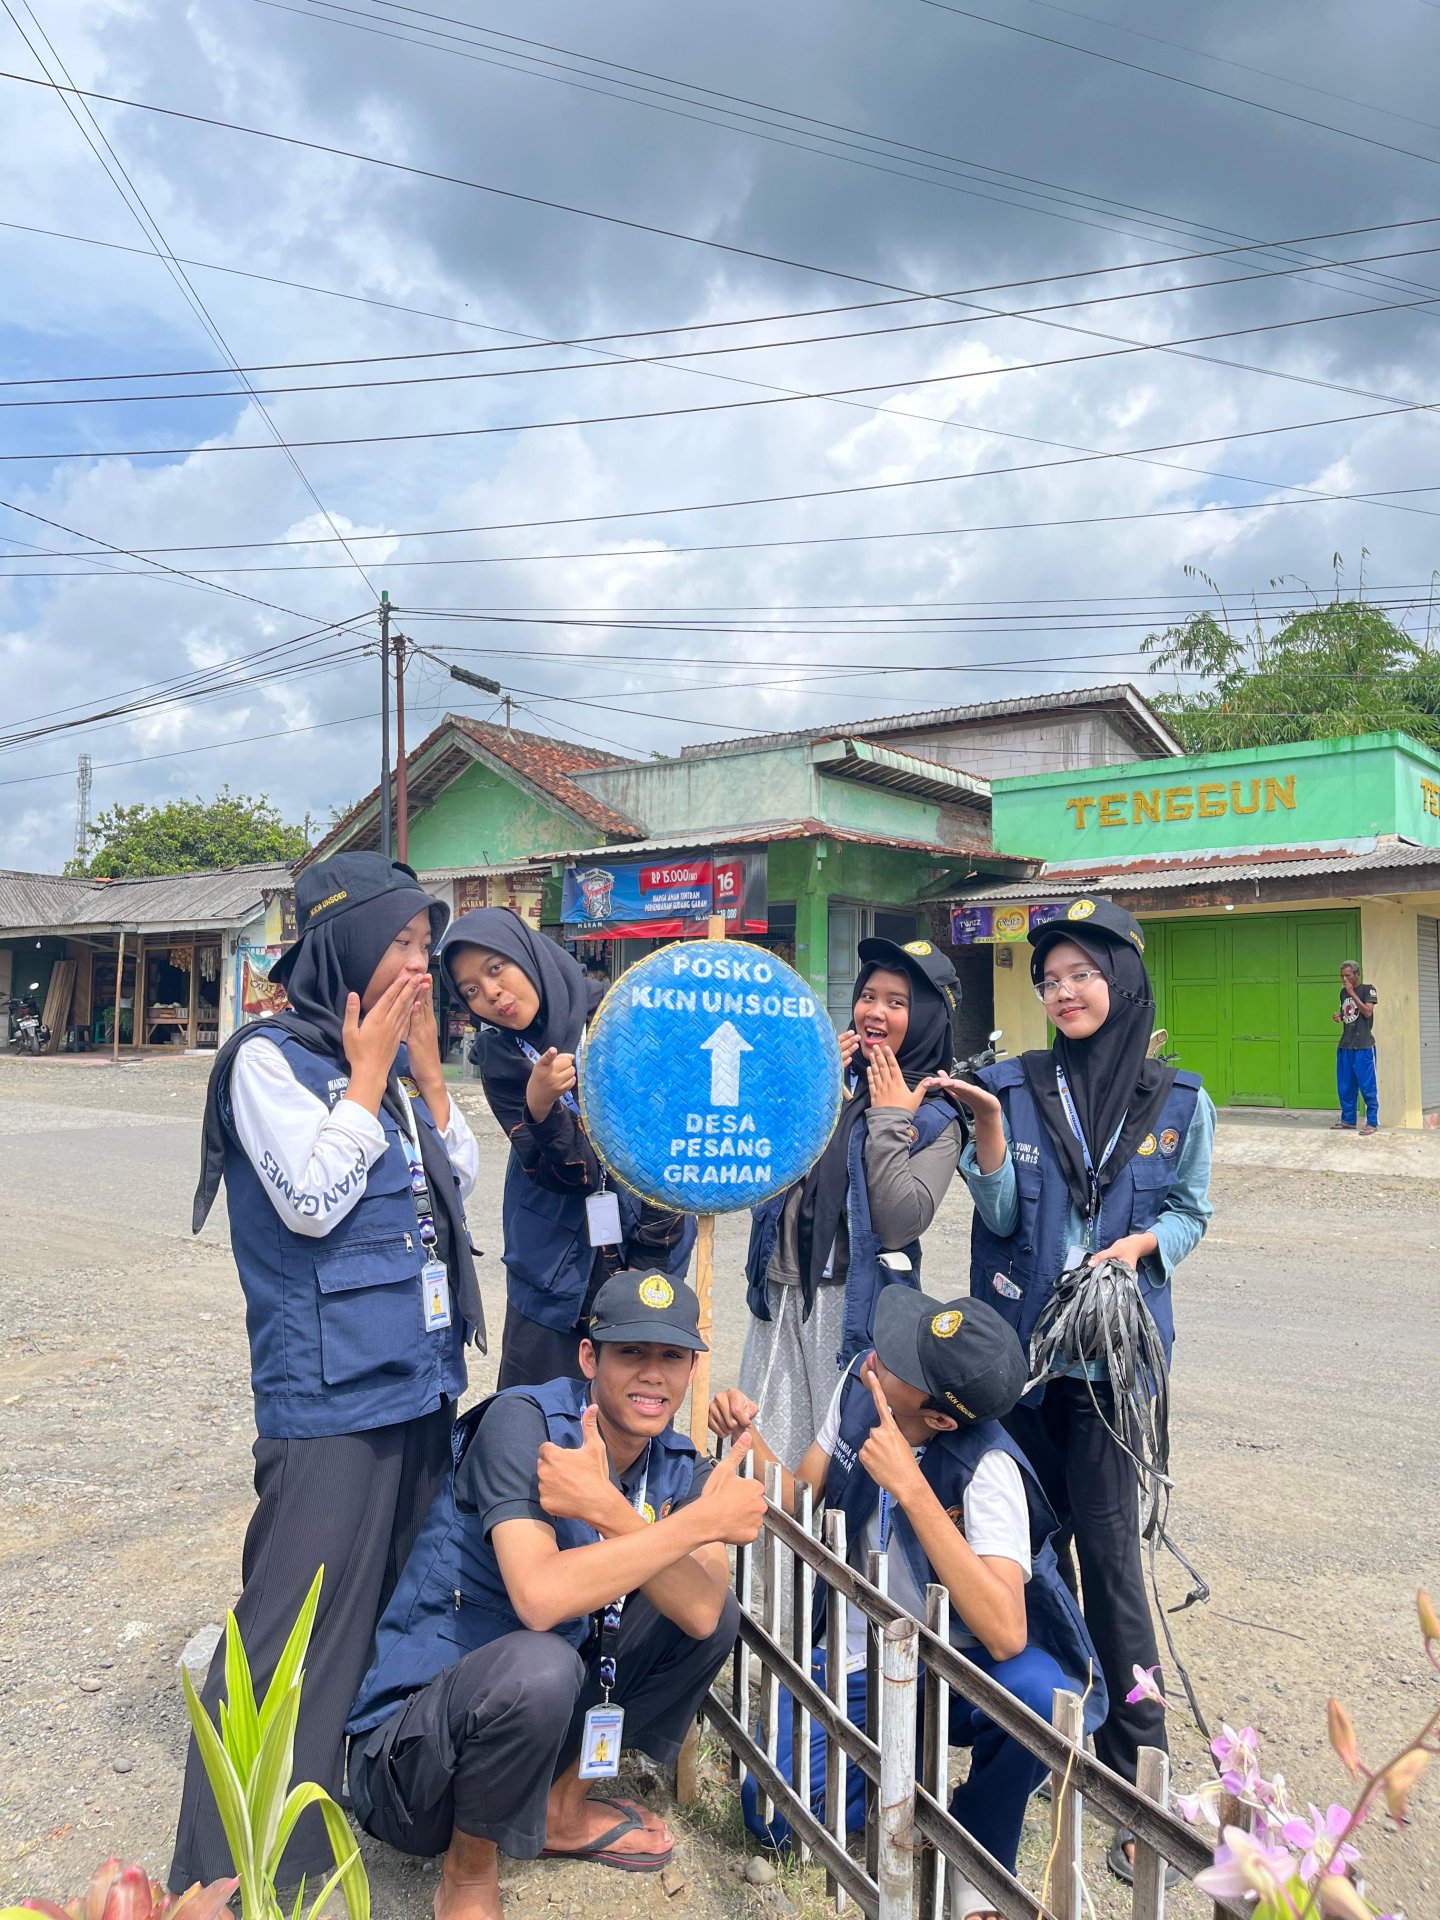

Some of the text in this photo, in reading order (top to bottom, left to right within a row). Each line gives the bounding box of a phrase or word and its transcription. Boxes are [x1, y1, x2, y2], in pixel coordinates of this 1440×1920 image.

[1067, 774, 1297, 830] TENGGUN
[717, 871, 734, 891] 16
[672, 956, 772, 984] POSKO
[631, 985, 816, 1019] KKN UNSOED
[685, 1113, 757, 1135] DESA
[669, 1137, 772, 1159] PESANG
[259, 1150, 366, 1217] ASIAN GAMES
[663, 1163, 772, 1185] GRAHAN
